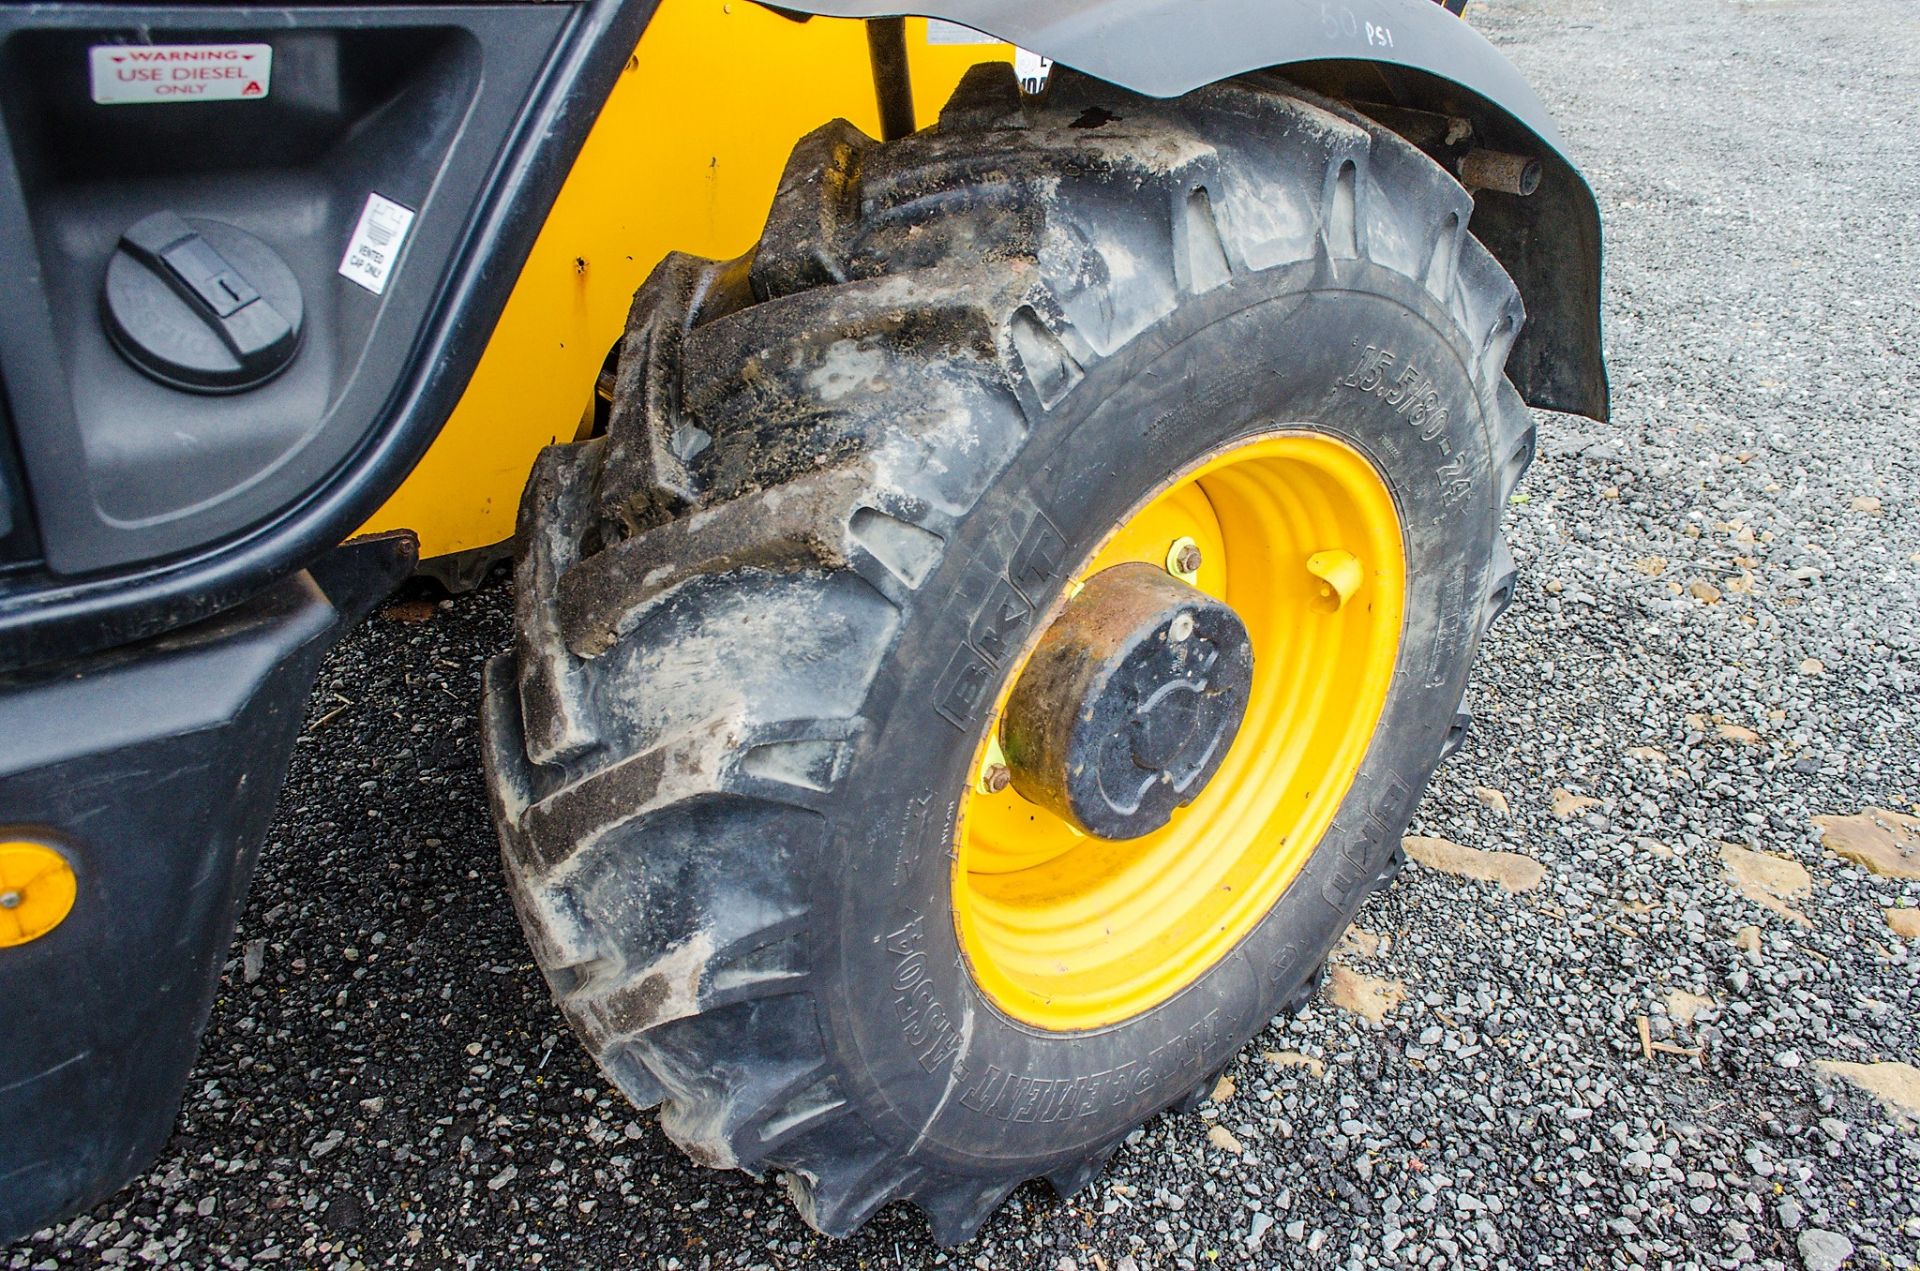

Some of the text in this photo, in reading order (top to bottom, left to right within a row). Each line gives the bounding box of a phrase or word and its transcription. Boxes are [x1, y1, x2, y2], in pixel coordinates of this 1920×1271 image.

[1365, 21, 1394, 48] PSI
[129, 51, 239, 61] WARNING
[117, 66, 248, 82] USE DIESEL
[155, 83, 207, 95] ONLY
[359, 244, 385, 265] VENTED
[350, 255, 383, 279] CAP ONLY
[934, 512, 1067, 731] BKT
